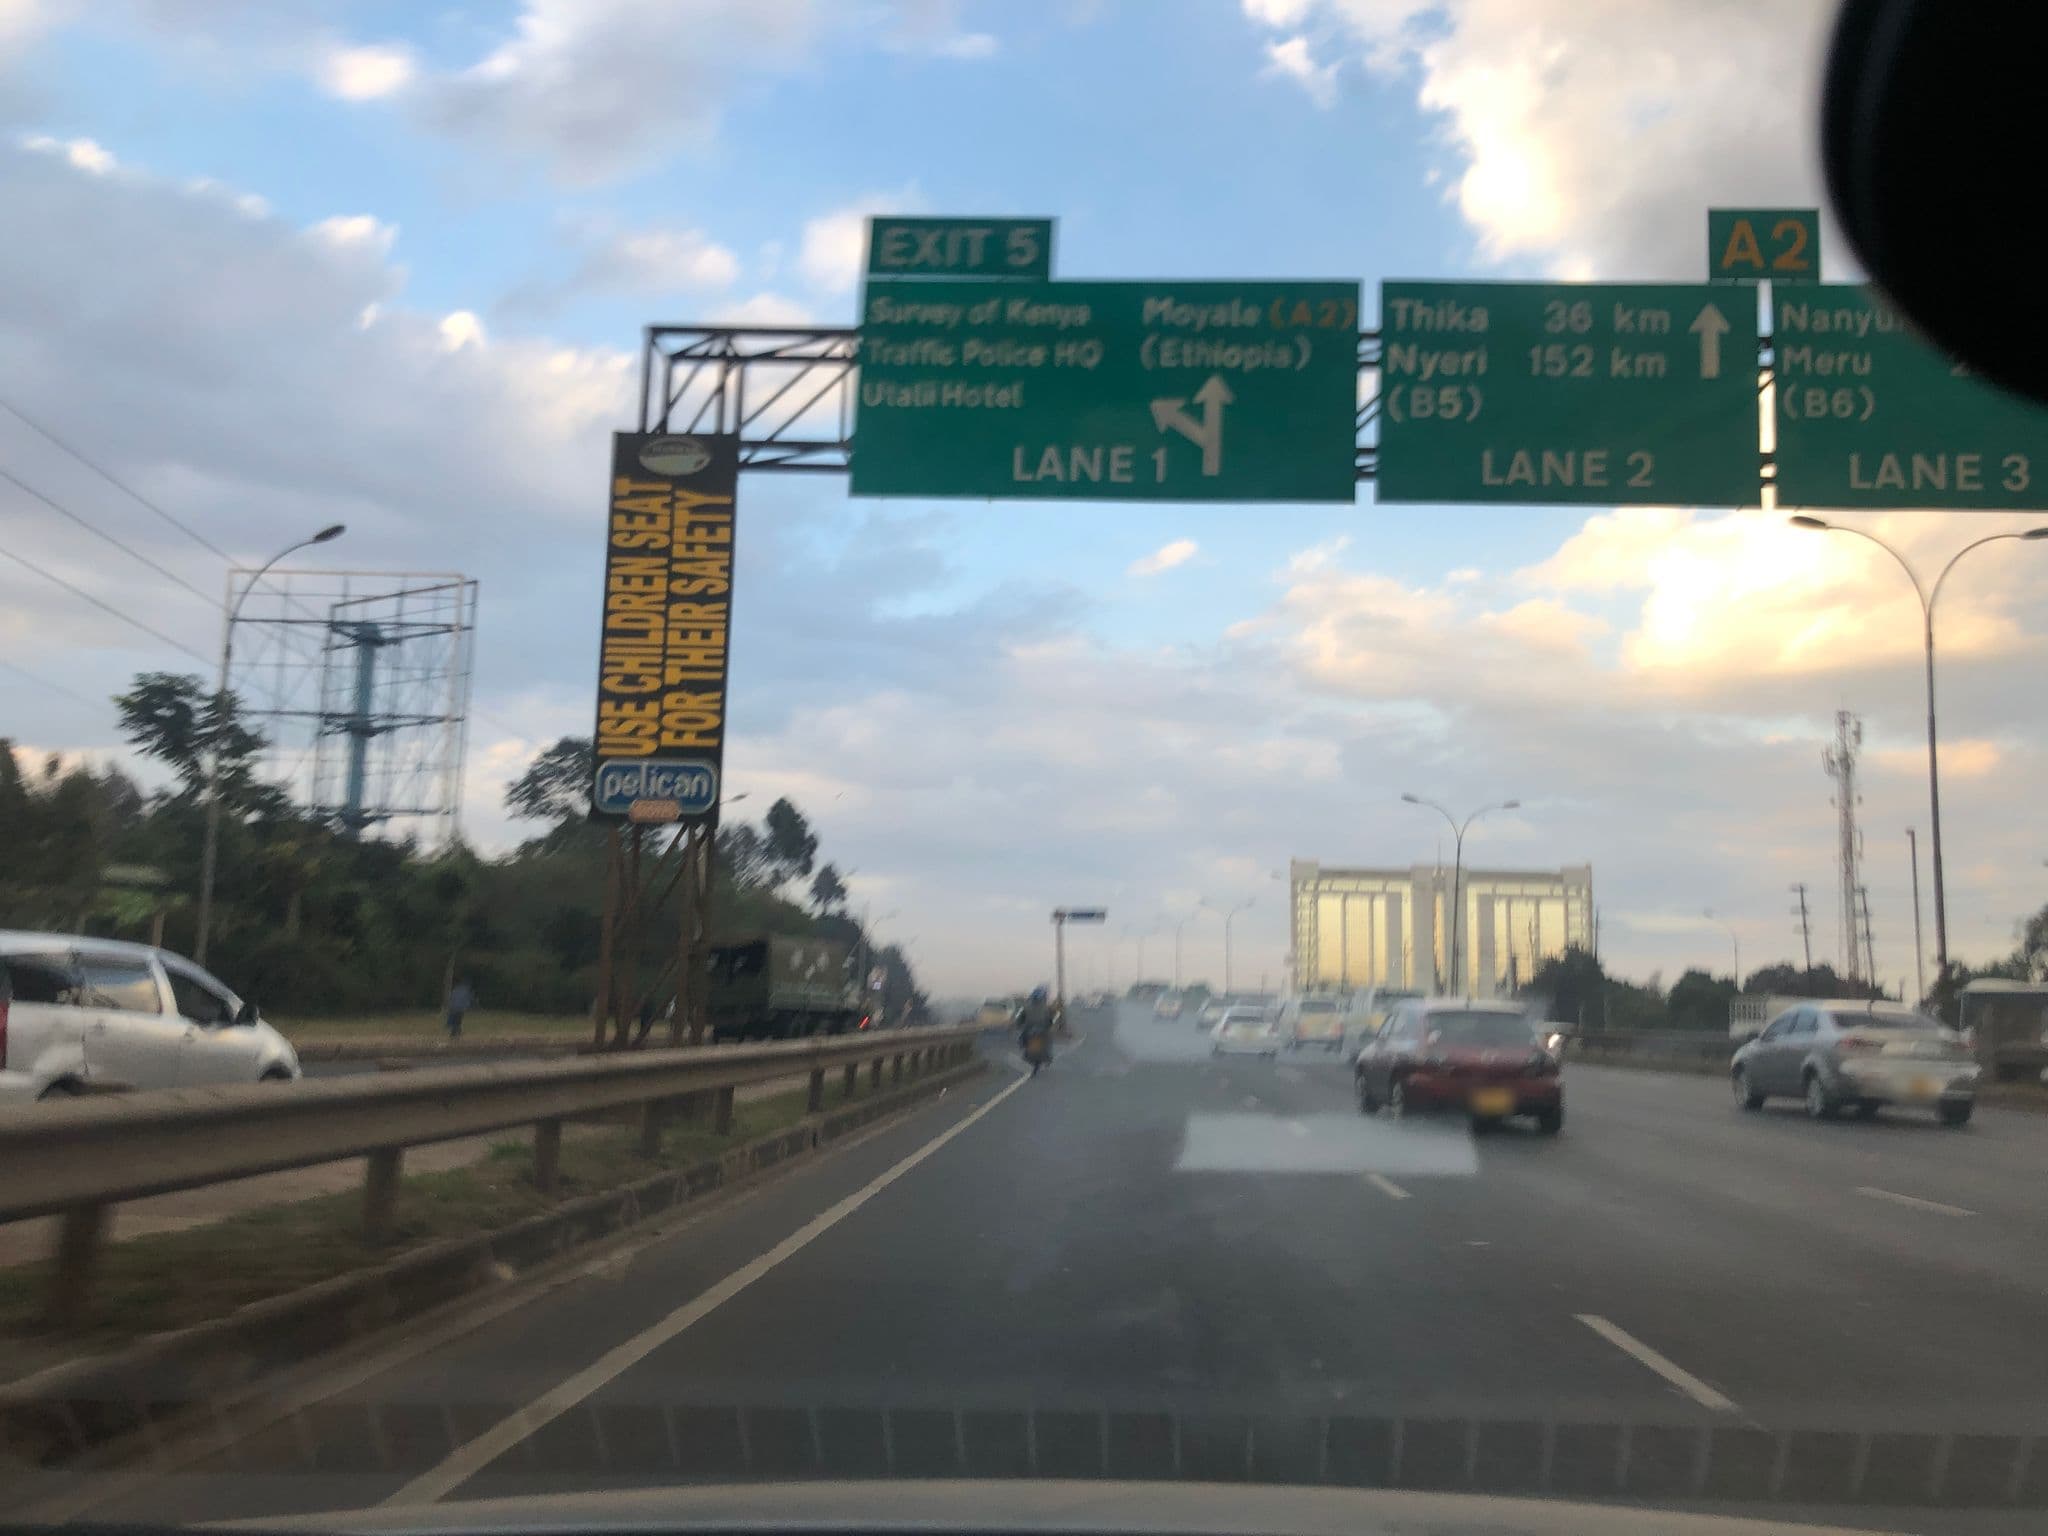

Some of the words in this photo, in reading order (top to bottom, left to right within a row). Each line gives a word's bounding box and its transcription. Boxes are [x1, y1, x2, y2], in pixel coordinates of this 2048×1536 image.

[879, 227, 992, 268] EXIT
[1007, 227, 1040, 268] 5
[1722, 219, 1809, 270] A2
[871, 298, 961, 329] Survey
[968, 298, 1000, 325] of
[1007, 299, 1091, 329] Kenya
[1143, 297, 1262, 331] Moyale
[1269, 297, 1356, 331] (A2)
[1390, 298, 1489, 332] Thika
[1544, 301, 1593, 333] 36
[1614, 303, 1671, 333] km
[1782, 303, 1902, 337] Nanyu
[867, 338, 955, 366] Traffic
[963, 339, 1046, 366] Police
[1054, 340, 1104, 369] HQ
[1140, 333, 1312, 372] (Ethiopia)
[1387, 344, 1487, 381] Nyeri
[1529, 345, 1594, 377] 152
[1610, 347, 1666, 377] km
[1782, 347, 1873, 376] Meru
[942, 381, 1024, 408] Hotel
[1388, 384, 1483, 422] (B5)
[1783, 384, 1875, 421] (B6)
[1013, 446, 1134, 483] LANE
[1152, 446, 1167, 483] 1
[1481, 450, 1609, 487] LANE
[1626, 451, 1655, 487] 2
[1849, 454, 1984, 491] LANE
[2002, 454, 2031, 491] 3
[612, 477, 672, 549] SEAT
[669, 490, 732, 595] SAFETY
[602, 557, 668, 693] CHILDREN
[664, 602, 728, 685] THEIR
[598, 701, 660, 756] USE
[660, 691, 722, 747] FOR
[603, 761, 709, 802] pelican
